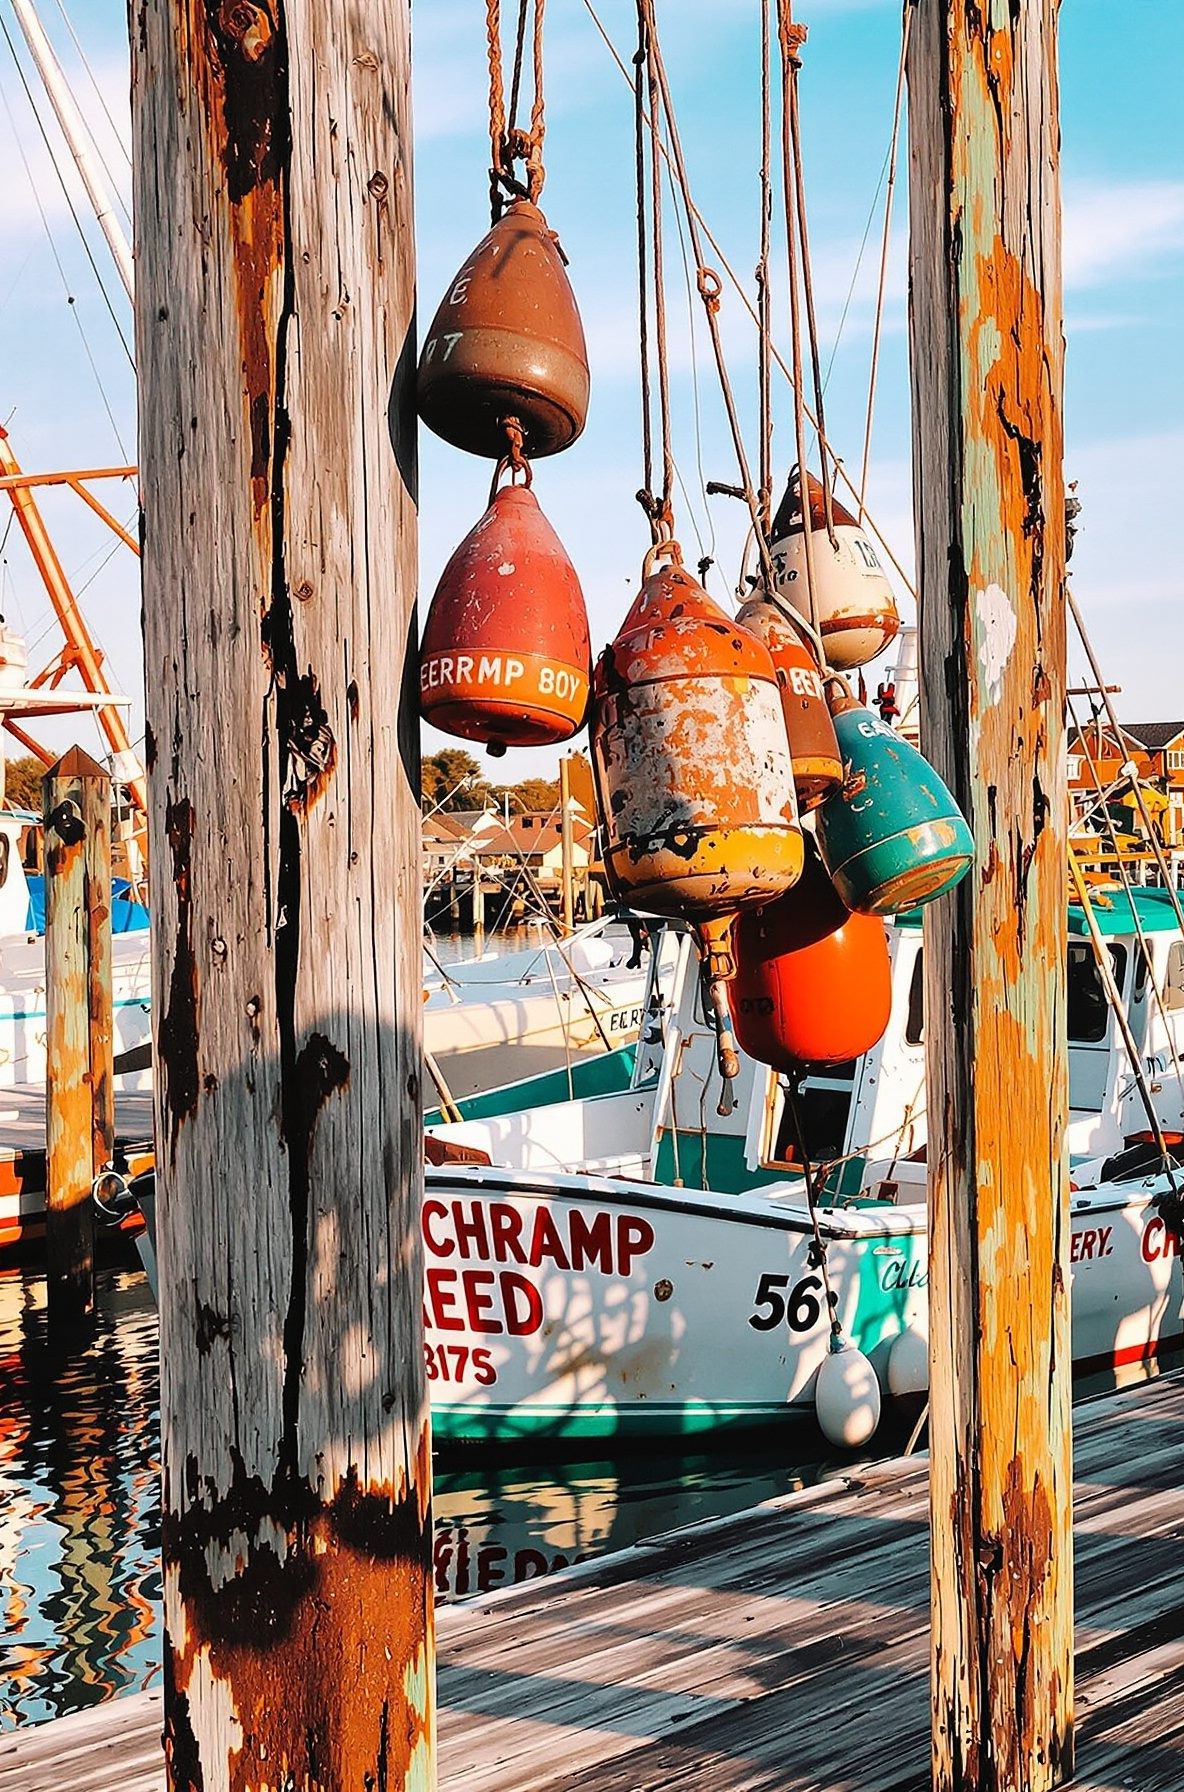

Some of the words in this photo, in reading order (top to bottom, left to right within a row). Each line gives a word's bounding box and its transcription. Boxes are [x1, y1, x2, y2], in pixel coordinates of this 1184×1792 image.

[538, 667, 580, 702] BOY
[421, 1199, 655, 1278] CHRAMP
[423, 1268, 545, 1337] EED
[748, 1272, 823, 1333] 56
